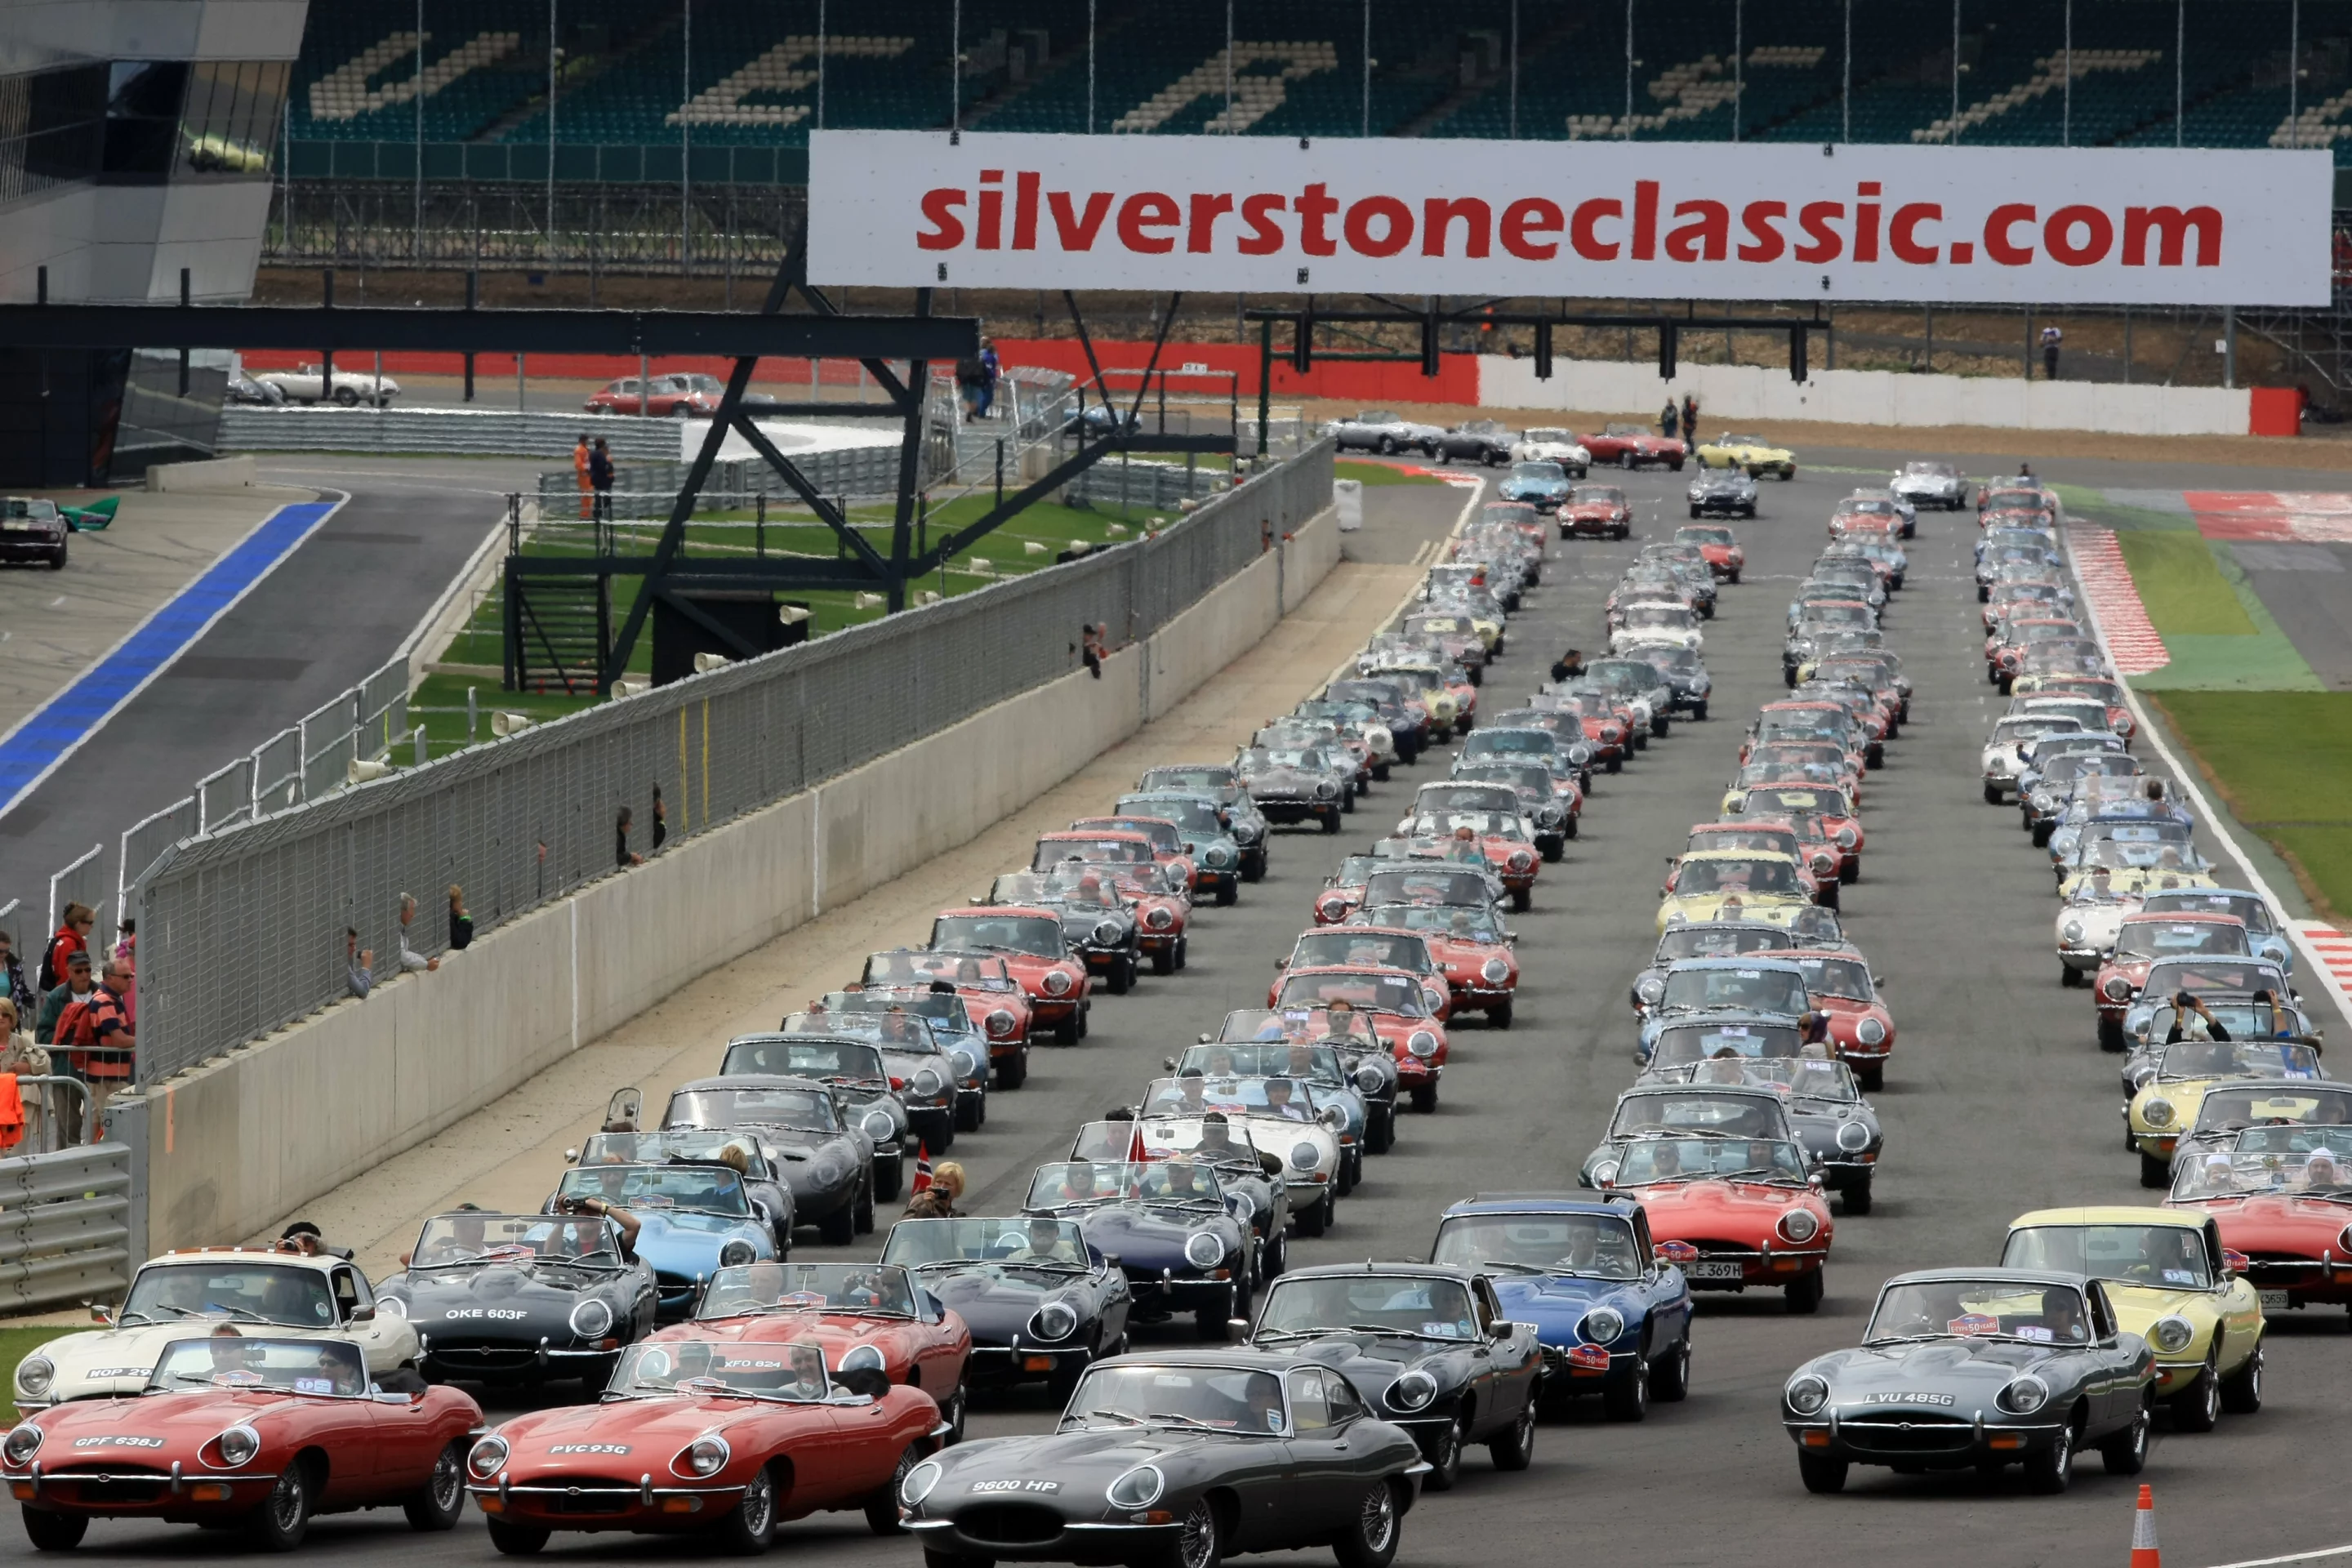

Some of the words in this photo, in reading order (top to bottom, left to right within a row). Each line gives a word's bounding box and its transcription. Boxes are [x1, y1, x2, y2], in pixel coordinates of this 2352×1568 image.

[916, 168, 2224, 268] silverstoneclassic.com
[1708, 1263, 1741, 1276] 369H
[445, 1308, 483, 1320] OKE
[487, 1309, 528, 1321] 603F
[1968, 1323, 1980, 1332] 50
[1980, 1321, 1997, 1330] YEARS
[724, 1359, 751, 1368] XFO
[1586, 1356, 1596, 1365] 50
[127, 1368, 154, 1377] 29
[1864, 1392, 1902, 1404] LVU
[1904, 1392, 1953, 1405] 485G
[75, 1437, 113, 1446] GPF
[114, 1437, 163, 1448] 638J
[972, 1480, 1021, 1491] 9600
[1025, 1480, 1058, 1491] HP
